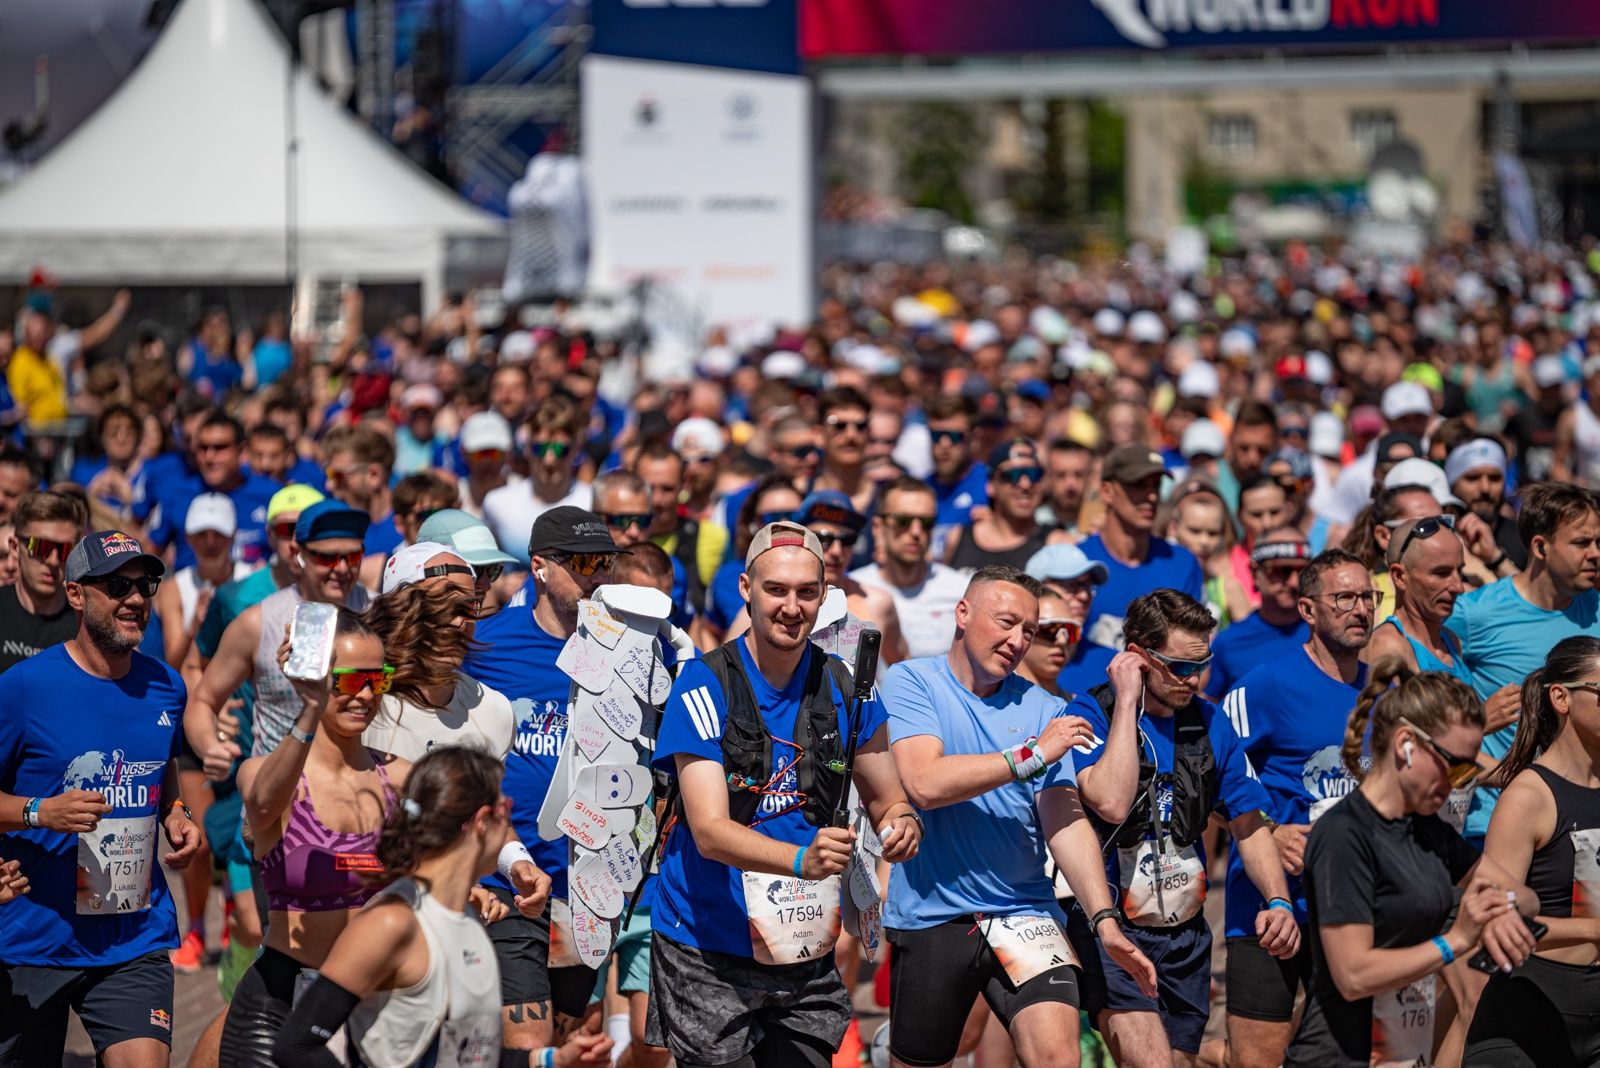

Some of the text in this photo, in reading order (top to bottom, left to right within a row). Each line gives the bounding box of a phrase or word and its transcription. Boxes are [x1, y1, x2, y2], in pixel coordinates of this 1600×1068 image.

[104, 544, 126, 557] Red
[537, 724, 564, 736] LIFE
[109, 774, 133, 786] LIFE
[106, 859, 145, 877] 17517
[783, 880, 813, 889] WINGS
[1147, 872, 1189, 895] 17859
[789, 886, 806, 895] LIFE
[778, 892, 817, 903] WORLDRUN 2026
[776, 903, 824, 924] 17594
[792, 930, 814, 939] Adam
[1016, 924, 1059, 943] 10498
